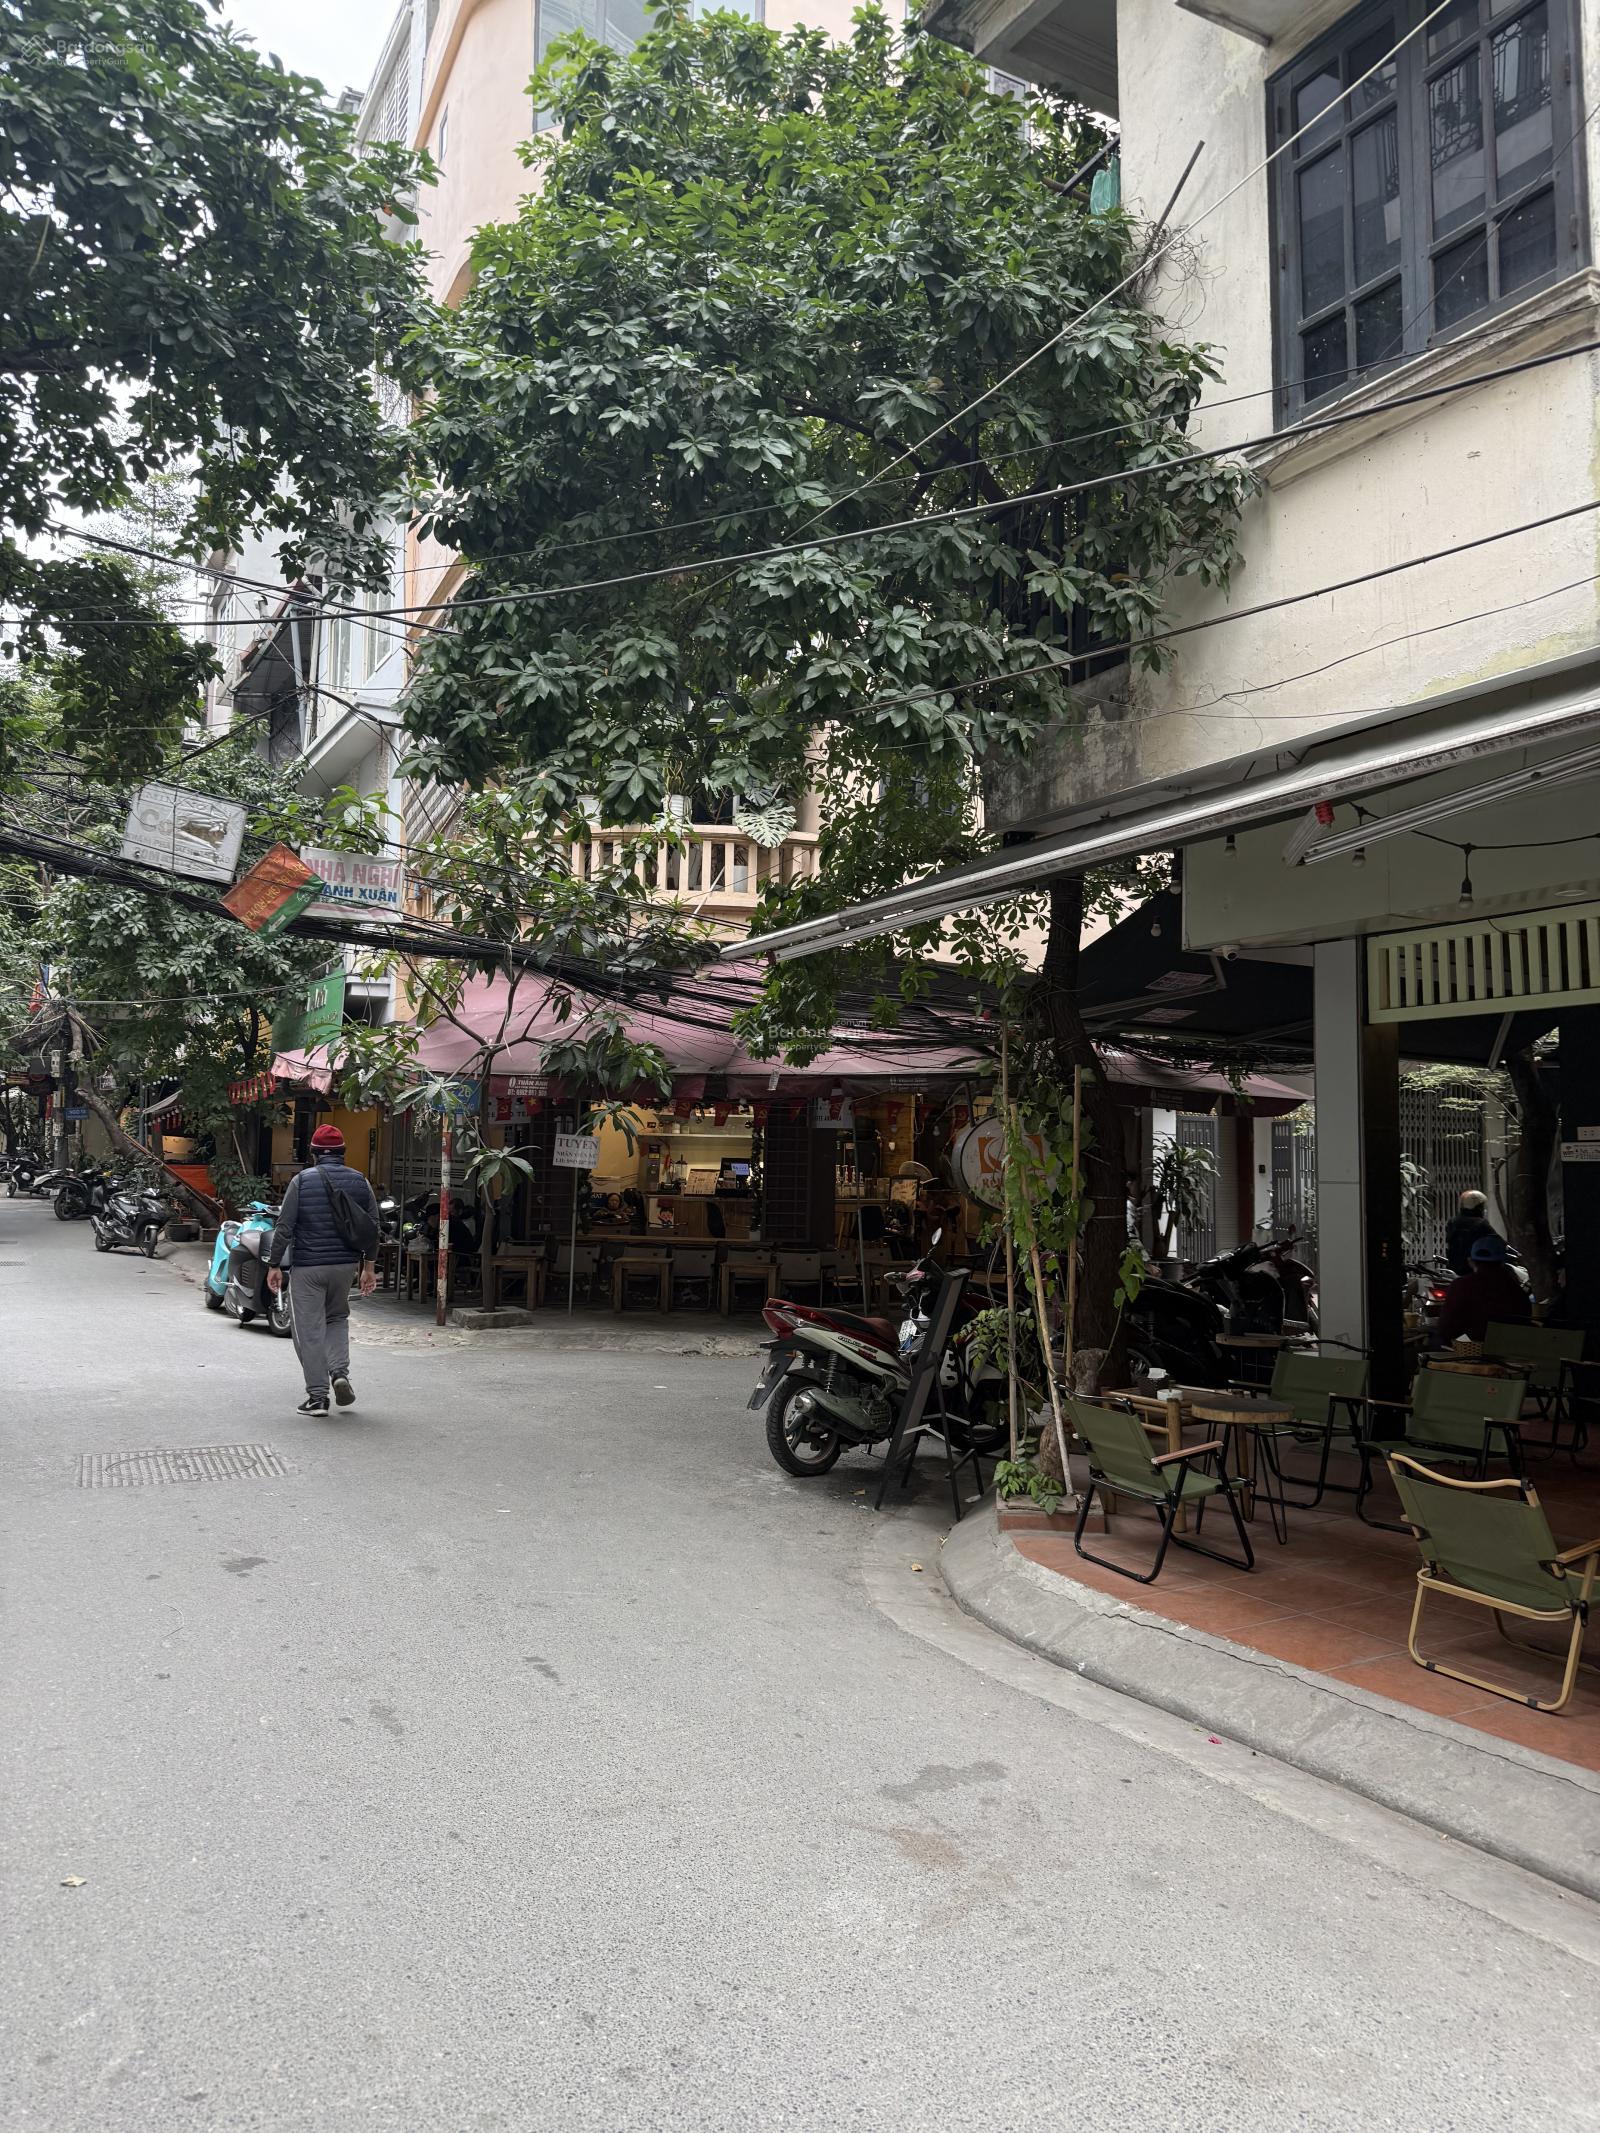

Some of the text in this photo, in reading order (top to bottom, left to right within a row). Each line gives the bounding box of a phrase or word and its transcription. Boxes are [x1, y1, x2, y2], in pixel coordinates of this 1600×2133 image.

[305, 857, 346, 883] NHÀ
[322, 885, 353, 898] ANH
[359, 887, 397, 903] XUÂN
